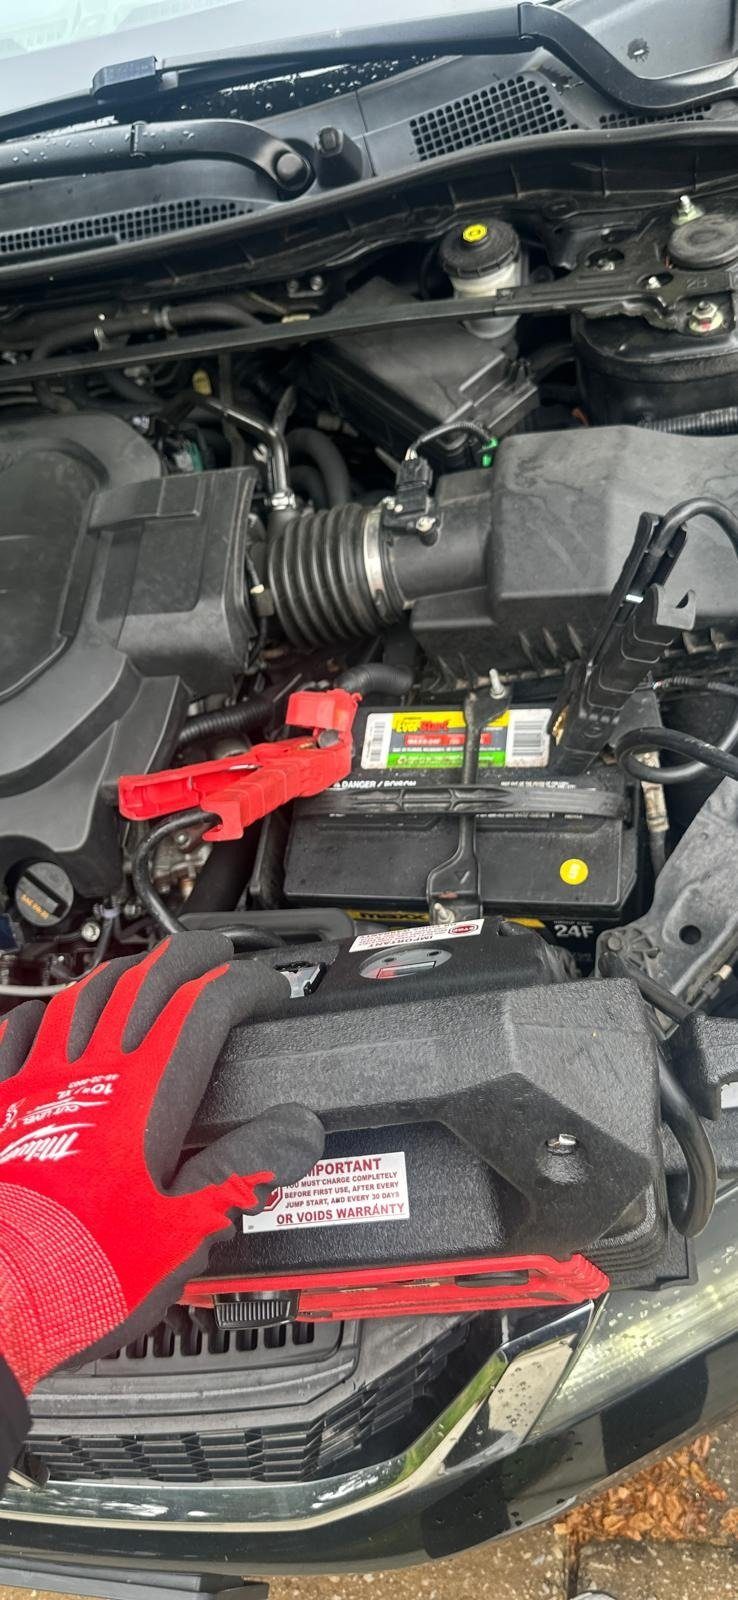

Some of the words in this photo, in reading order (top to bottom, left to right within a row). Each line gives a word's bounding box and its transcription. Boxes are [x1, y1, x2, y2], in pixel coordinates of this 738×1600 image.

[341, 780, 377, 789] DANGER
[554, 924, 594, 939] 24F
[300, 1179, 320, 1188] MUST
[322, 1176, 350, 1185] CHARGE
[352, 1171, 398, 1182] COMPLETELY
[284, 1190, 312, 1199] BEFORE
[313, 1187, 333, 1196] FIRST
[334, 1186, 351, 1194] USE,
[352, 1183, 375, 1192] AFTER
[376, 1181, 399, 1190] EVERY
[285, 1201, 305, 1209] JUMP
[305, 1199, 330, 1207] START,
[347, 1194, 370, 1203] EVERY
[371, 1192, 380, 1200] 30
[381, 1191, 400, 1199] DAYS
[276, 1212, 294, 1225] OR
[296, 1208, 333, 1223] VOIDS
[336, 1203, 405, 1219] WARRANTY
